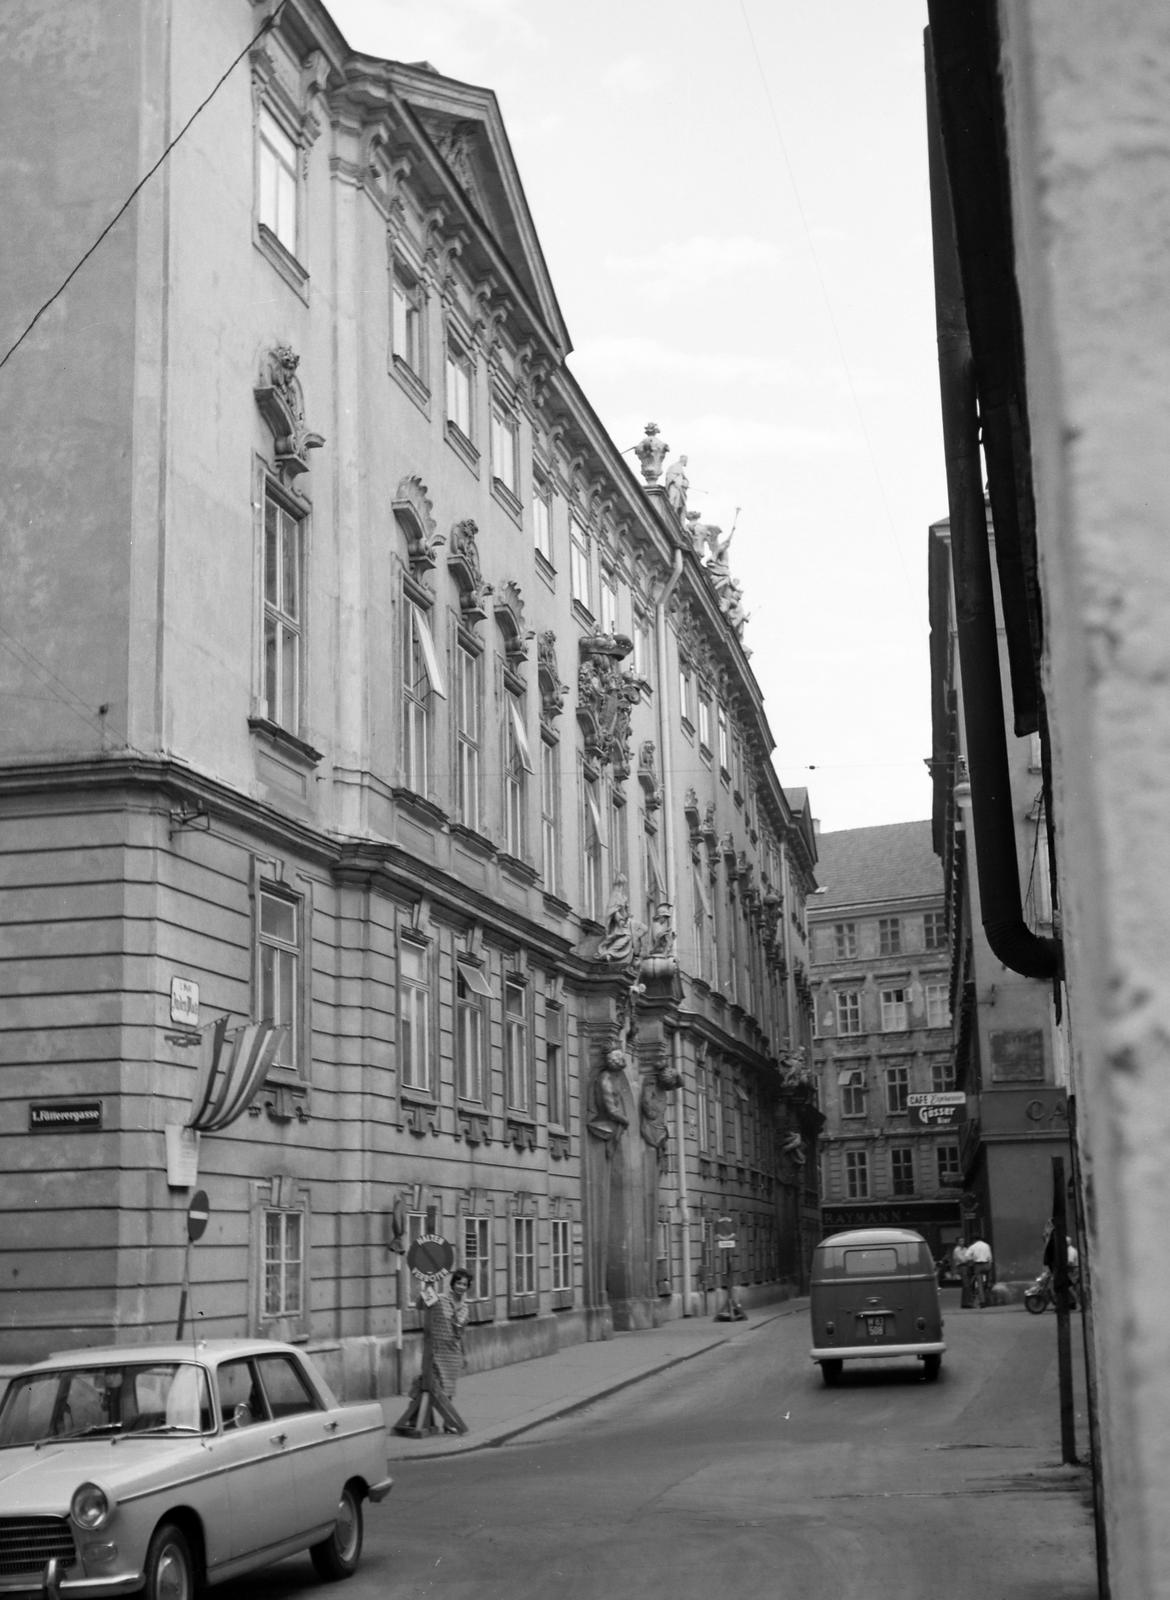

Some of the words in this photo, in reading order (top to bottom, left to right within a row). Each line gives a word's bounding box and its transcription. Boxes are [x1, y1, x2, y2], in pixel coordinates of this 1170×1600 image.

[919, 1106, 956, 1124] Gösser
[416, 1234, 445, 1246] HALTEN
[412, 1267, 449, 1282] VERBOTEN
